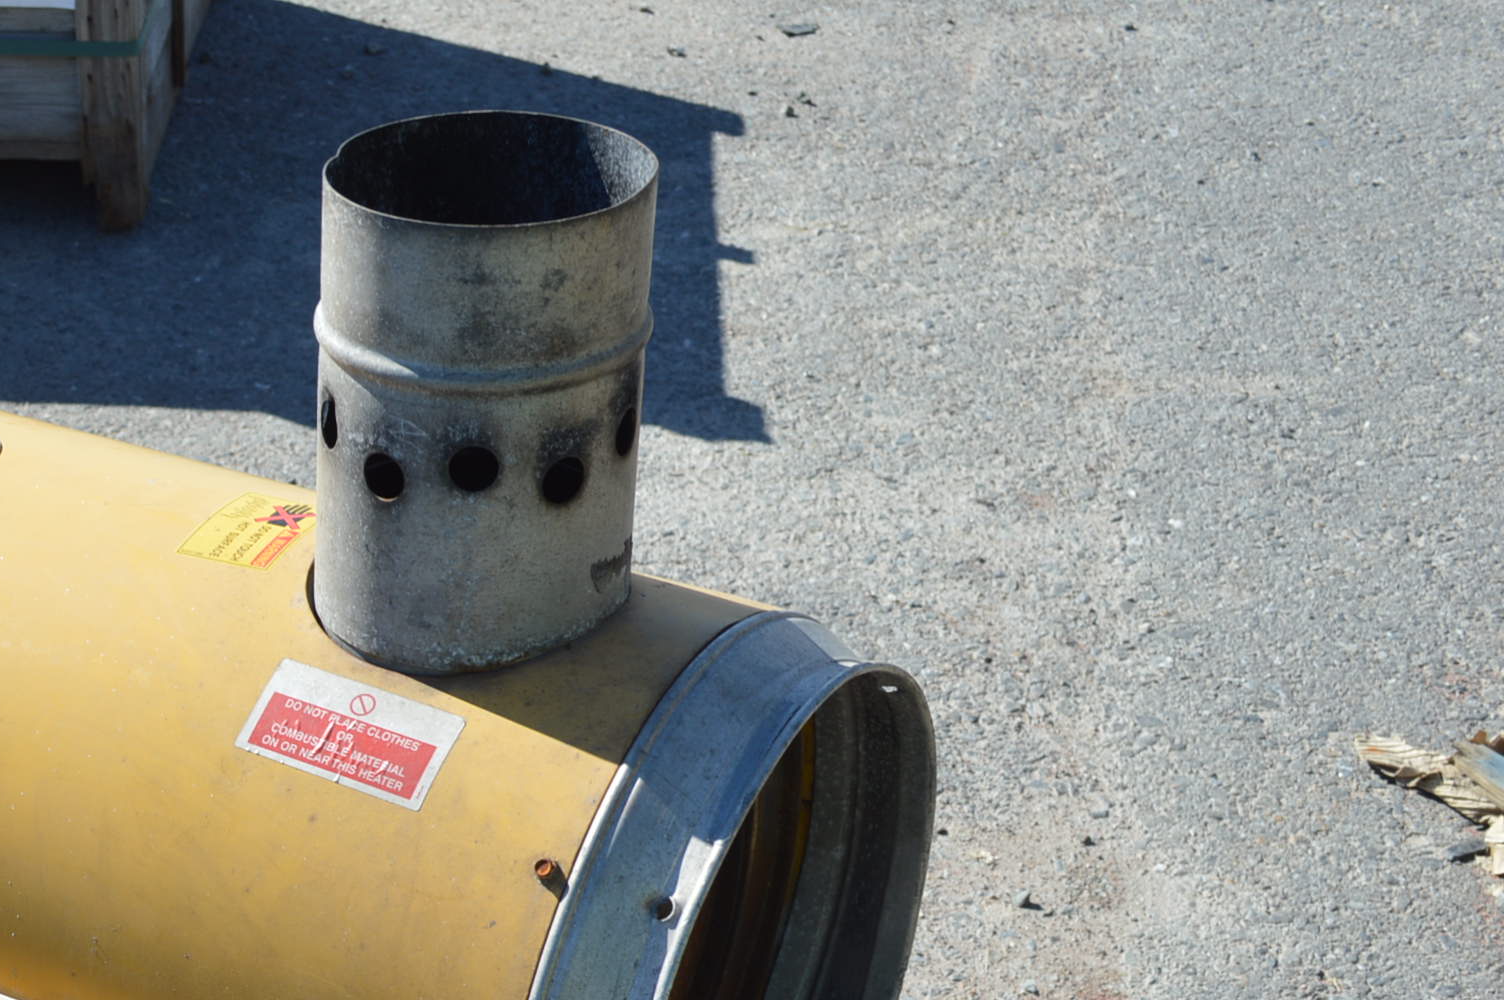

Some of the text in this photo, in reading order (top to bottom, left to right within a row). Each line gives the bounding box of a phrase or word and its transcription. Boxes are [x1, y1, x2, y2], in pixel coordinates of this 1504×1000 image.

[285, 698, 420, 752] DO NOT PLACE CLOTHES
[336, 730, 354, 743] OR
[262, 735, 403, 791] ON OR NEAR THIS HEATER
[350, 751, 405, 778] MATERIAL
